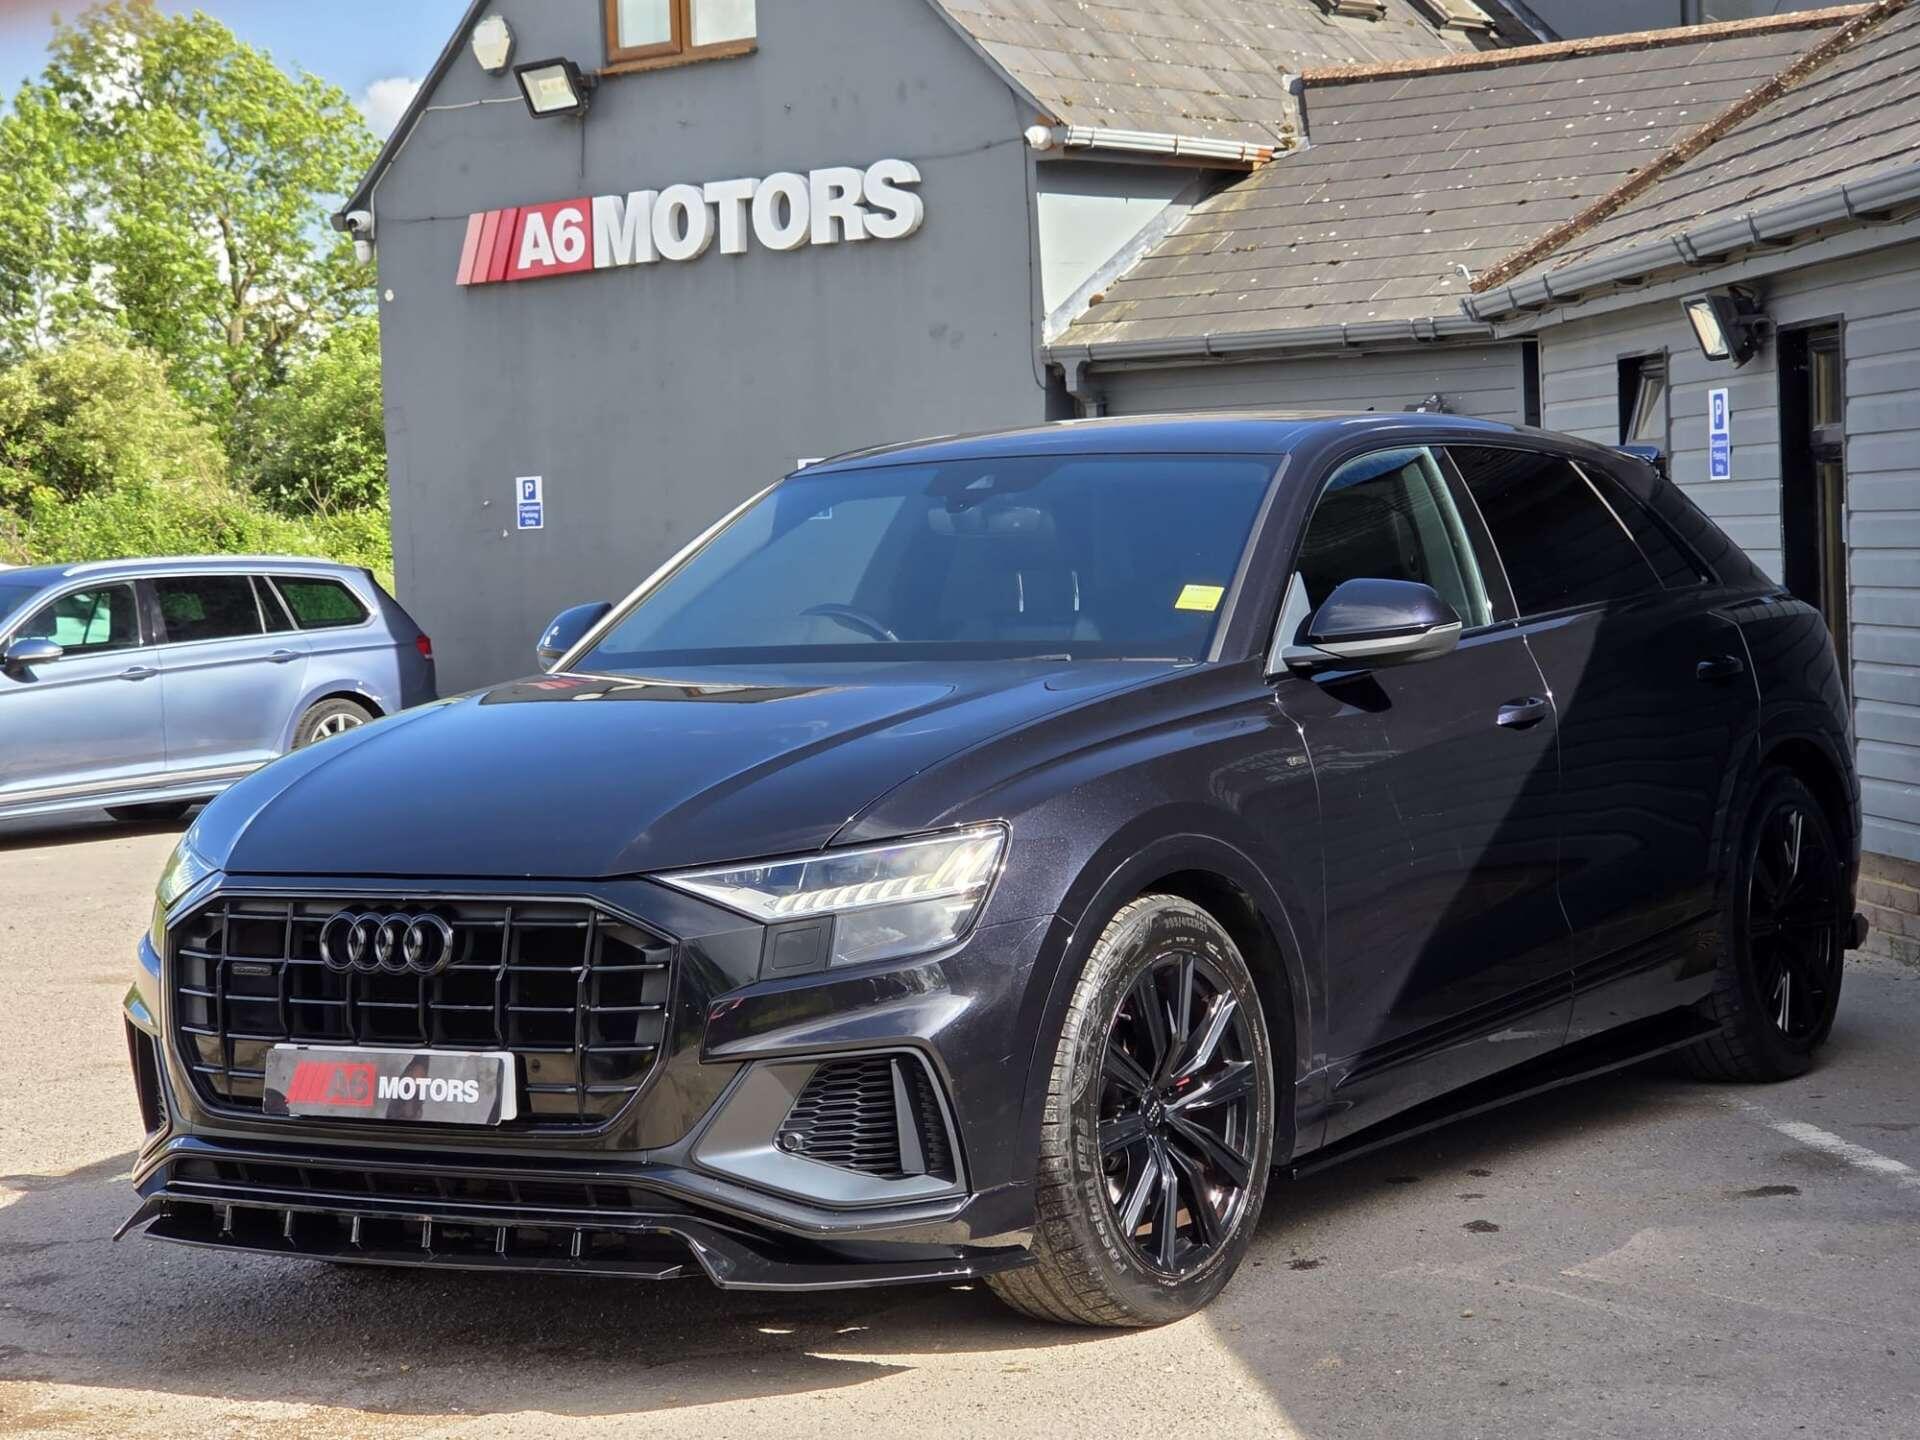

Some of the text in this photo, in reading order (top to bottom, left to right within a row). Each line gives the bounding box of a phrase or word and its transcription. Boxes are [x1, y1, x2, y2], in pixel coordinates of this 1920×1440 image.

[517, 159, 923, 270] A6 MOTORS
[1715, 398, 1722, 424] P
[525, 482, 534, 498] P
[329, 1069, 479, 1102] A6 MOTORS
